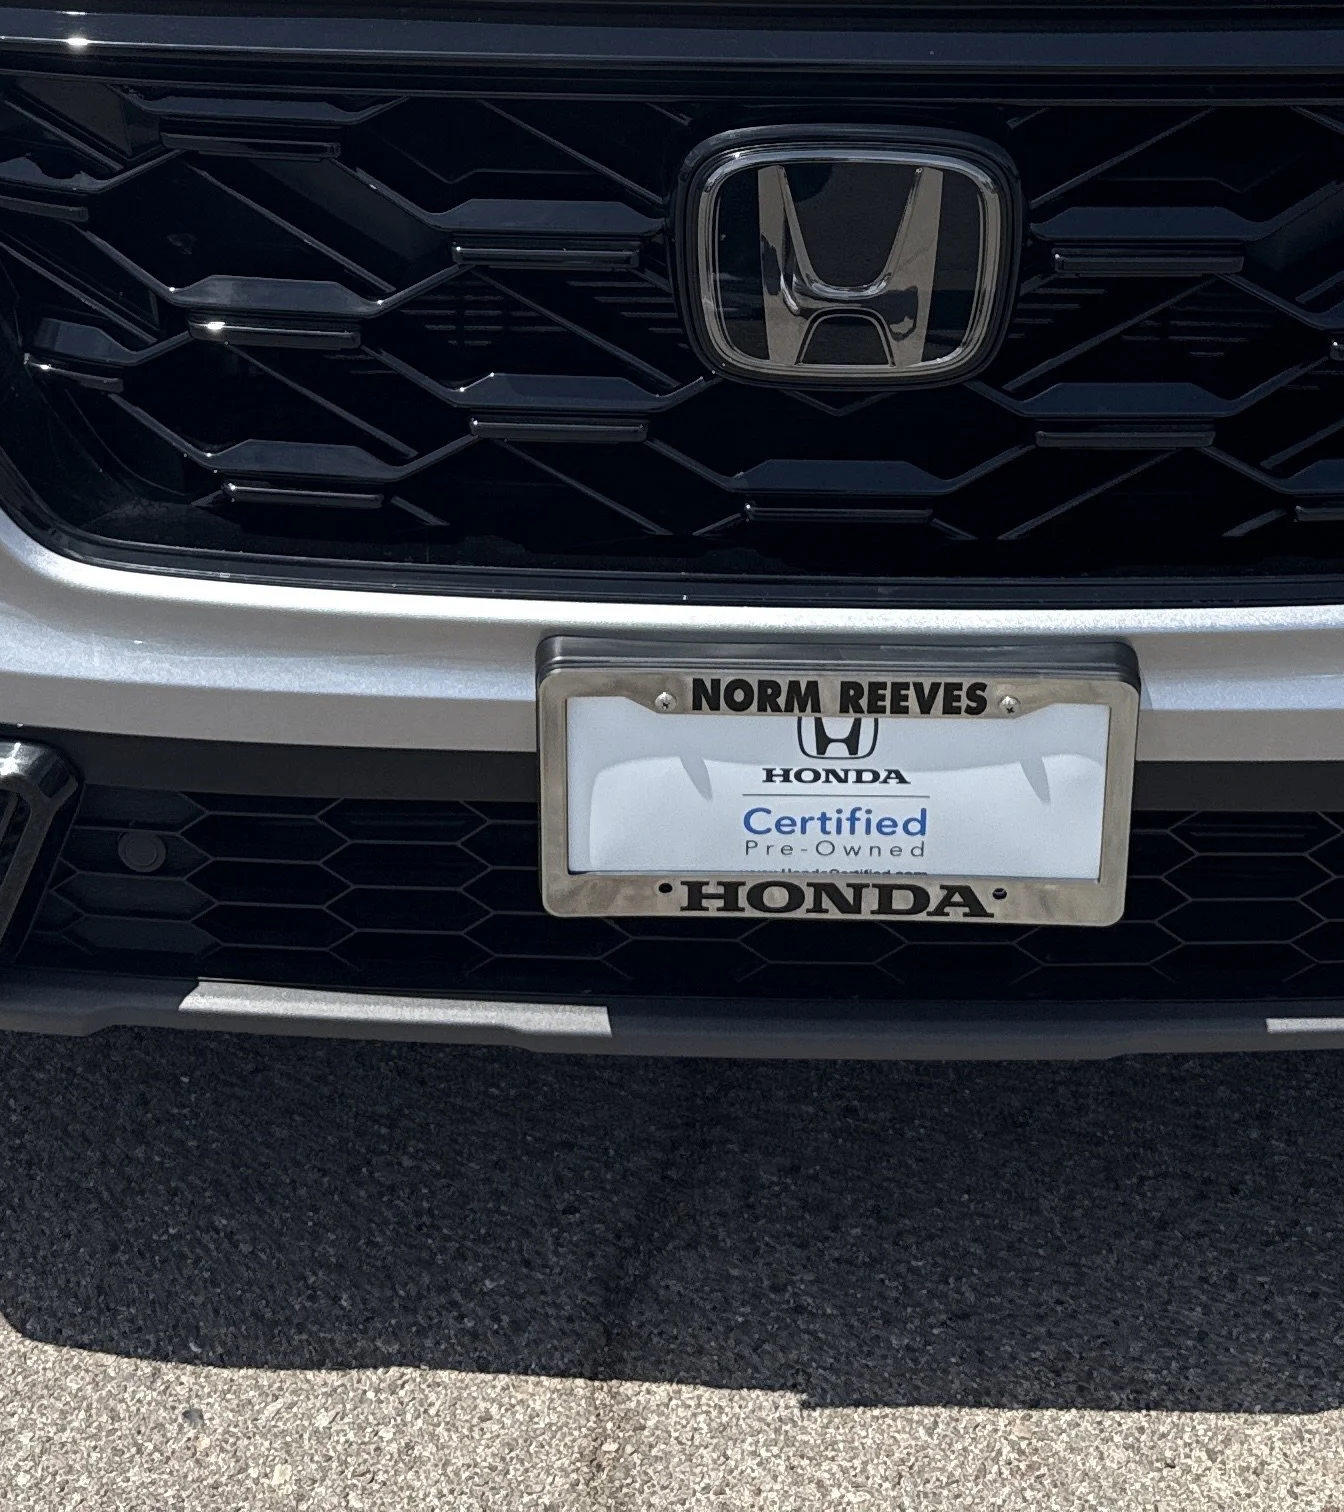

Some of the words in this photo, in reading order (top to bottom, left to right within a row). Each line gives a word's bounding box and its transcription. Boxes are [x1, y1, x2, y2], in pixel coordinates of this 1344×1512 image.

[691, 677, 822, 714] NORM
[838, 679, 989, 716] REEVES
[761, 767, 912, 785] HONDA
[743, 806, 928, 837] Certified
[744, 839, 926, 858] Pre-Owned
[679, 880, 995, 919] HONDA
